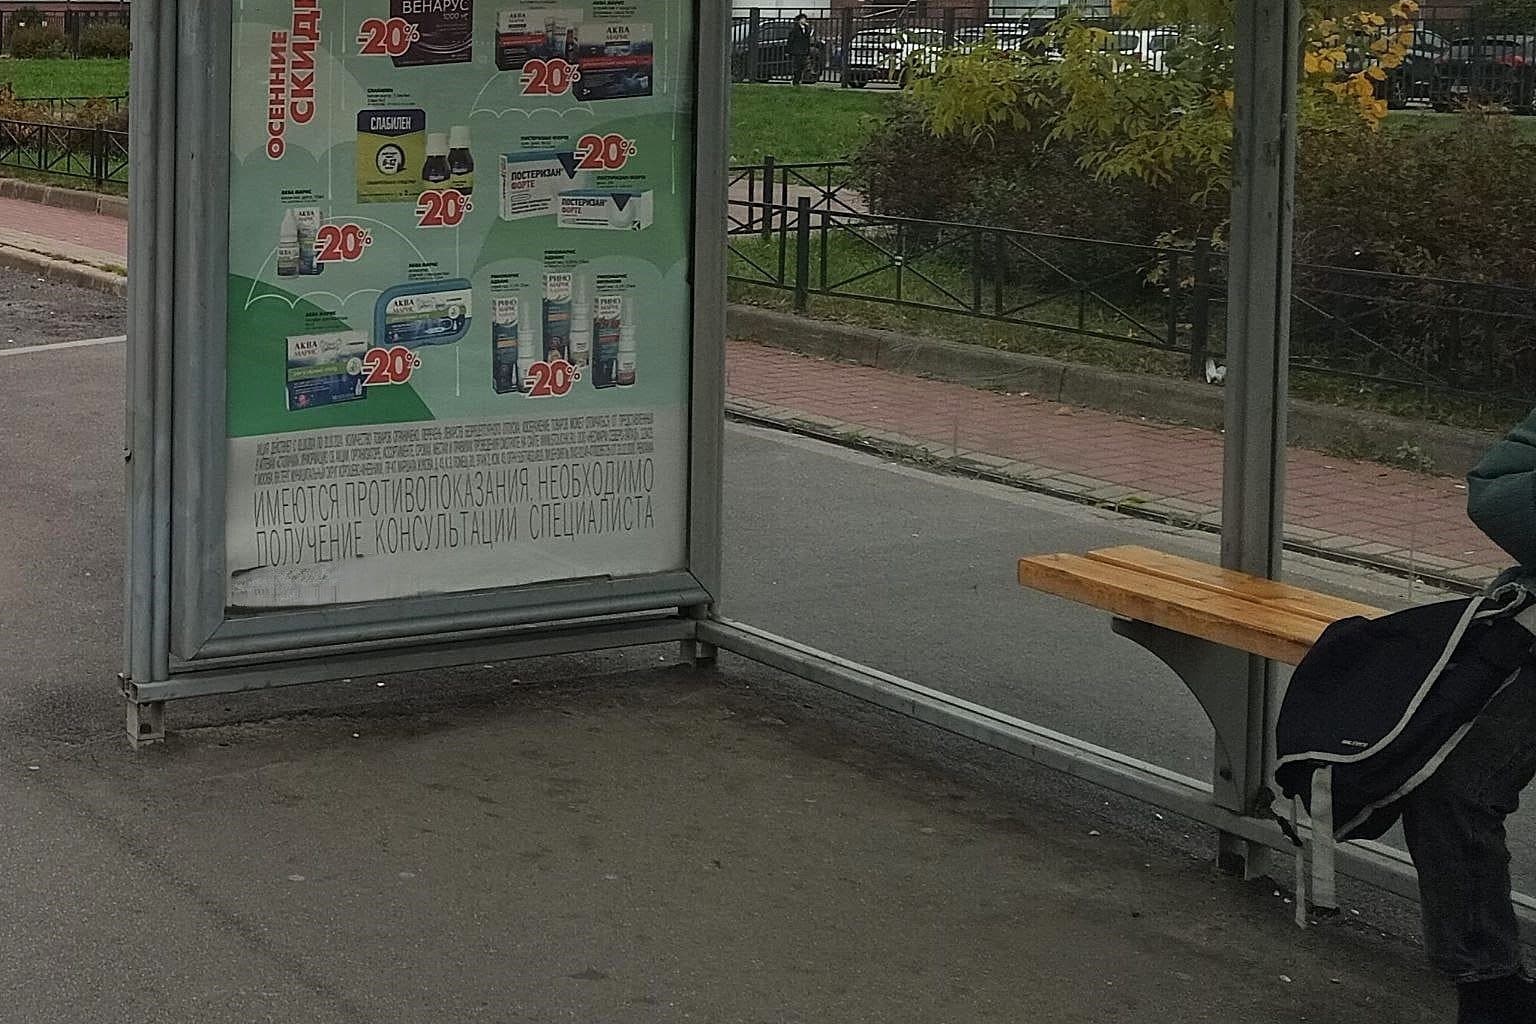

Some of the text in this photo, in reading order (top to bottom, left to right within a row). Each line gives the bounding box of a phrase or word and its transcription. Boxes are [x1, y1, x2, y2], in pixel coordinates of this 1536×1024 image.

[356, 17, 421, 56] -20%
[266, 31, 288, 159] ОСЕННИЕ
[520, 58, 581, 96] -20%
[370, 116, 411, 130] СЛАБИЛЕН
[574, 133, 637, 170] -20%
[415, 189, 473, 228] -20%
[313, 223, 373, 262] -20%
[362, 346, 422, 386] -20%
[524, 359, 581, 398] -20%
[254, 458, 654, 527] ИМЕЮТСЯ ПРОТИВОПОКАЗАНИЯ. НЕОБХОДИМО
[256, 495, 654, 567] ПОЛУЧЕНИЕ КОНСУЛЬТАЦИИ СПЕЦИАЛИСТА
